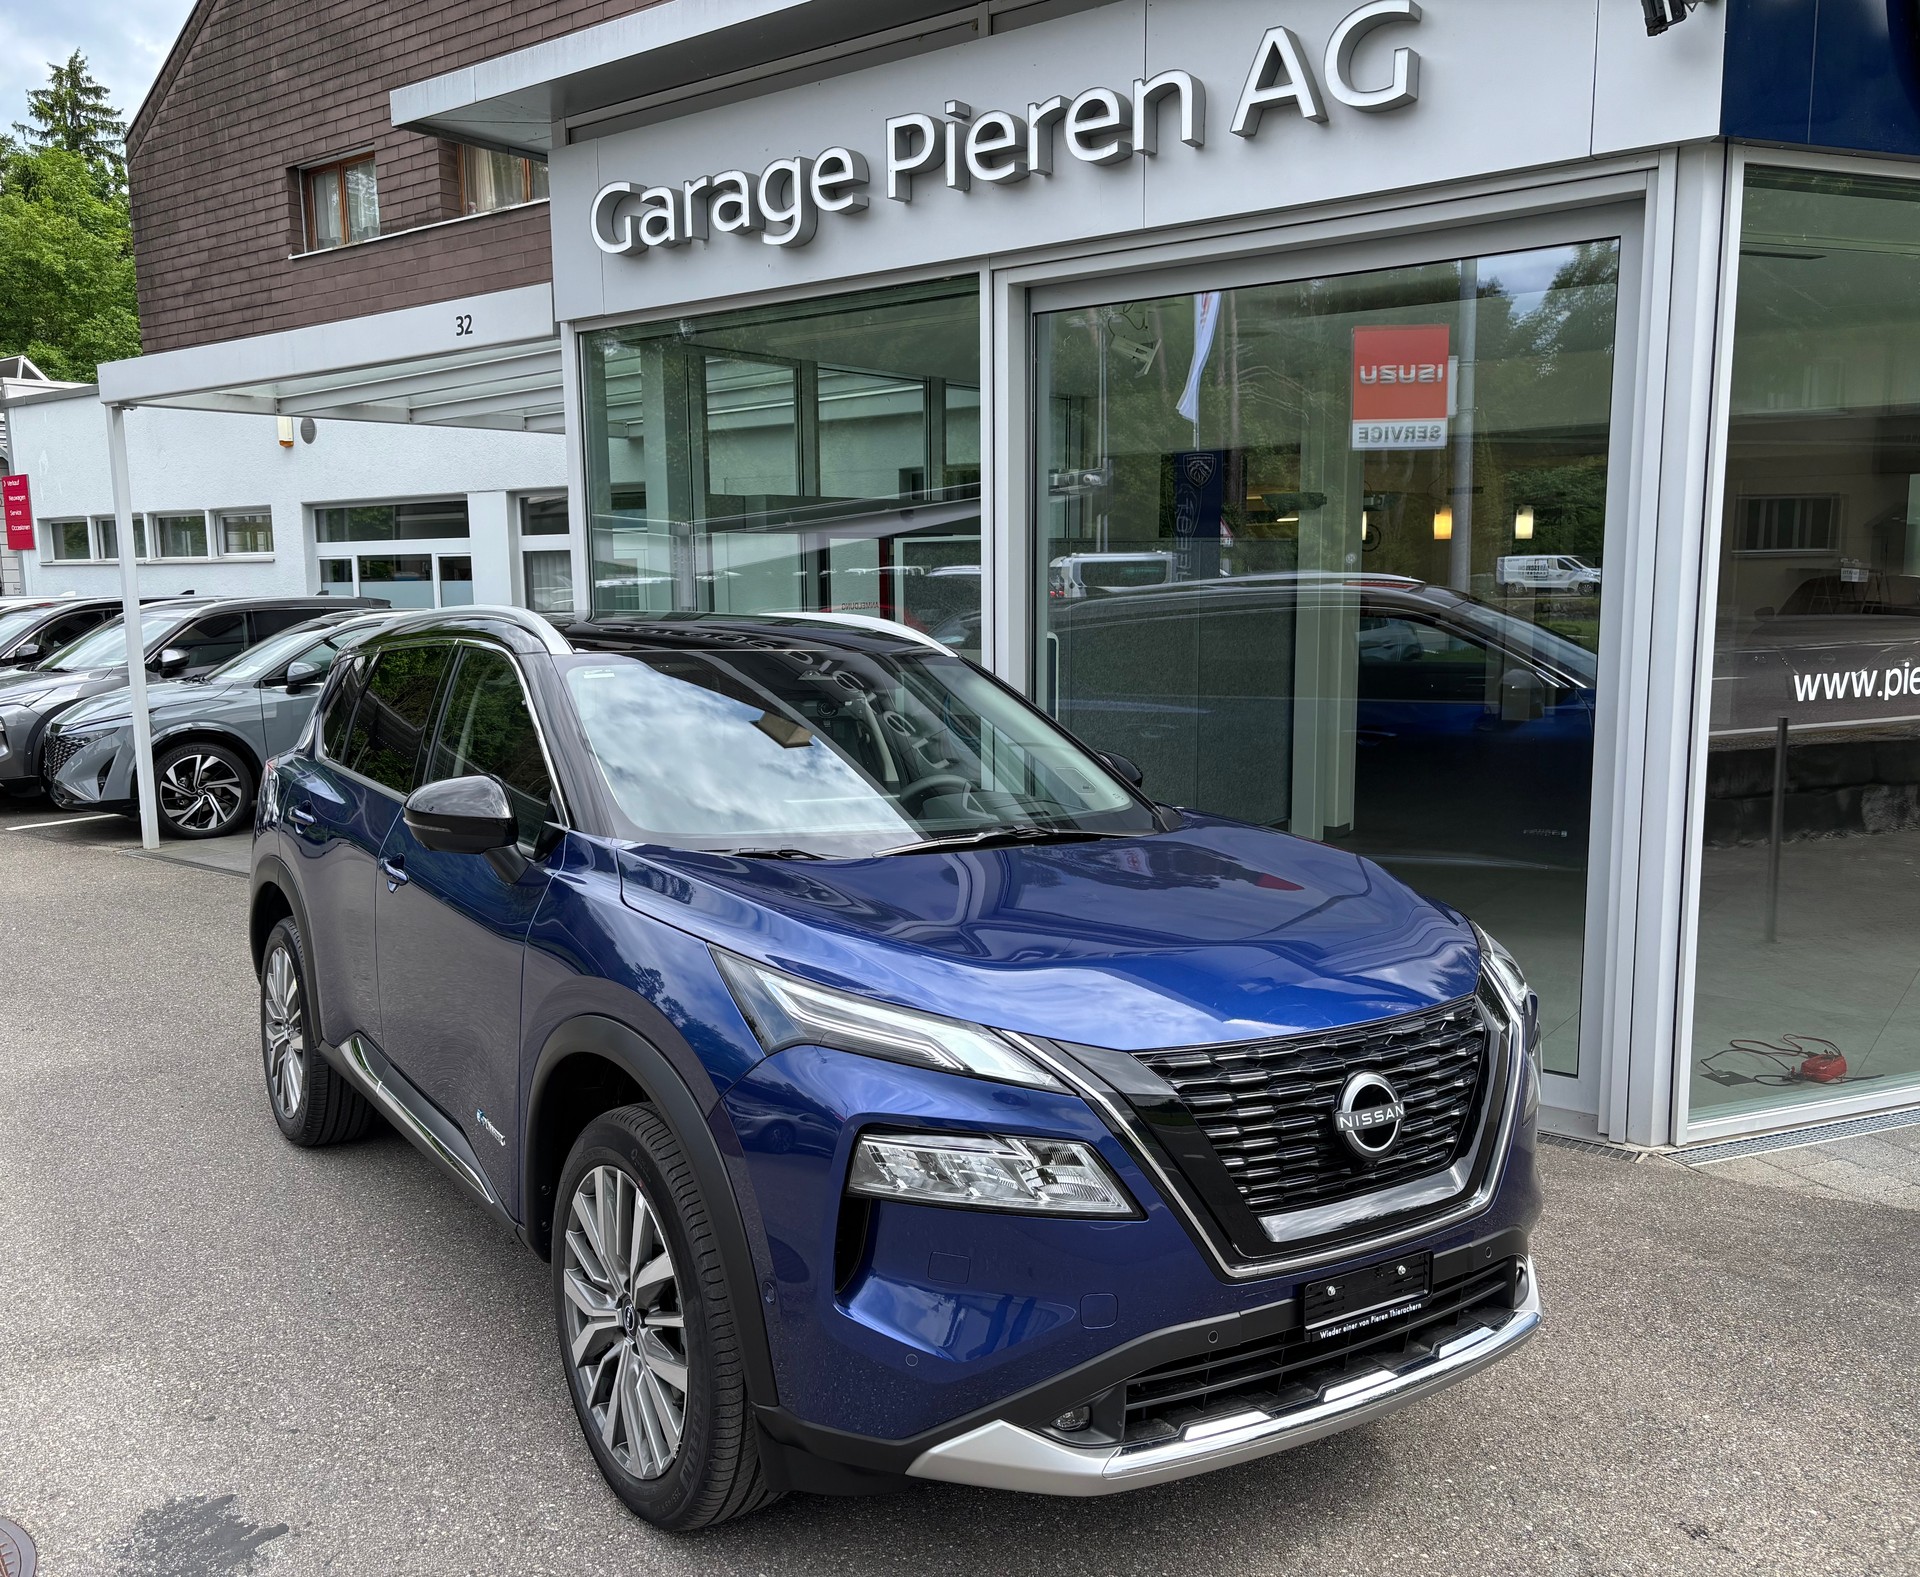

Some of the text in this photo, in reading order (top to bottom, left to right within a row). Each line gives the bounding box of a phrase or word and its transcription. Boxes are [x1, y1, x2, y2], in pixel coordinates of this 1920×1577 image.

[589, 0, 1419, 256] Garage Pieren AG
[455, 314, 473, 336] 32
[1340, 1103, 1404, 1129] NISSAN
[1319, 1327, 1342, 1340] Wieder
[1343, 1322, 1358, 1332] einer
[1359, 1319, 1370, 1327] von
[1370, 1312, 1389, 1324] Pieren
